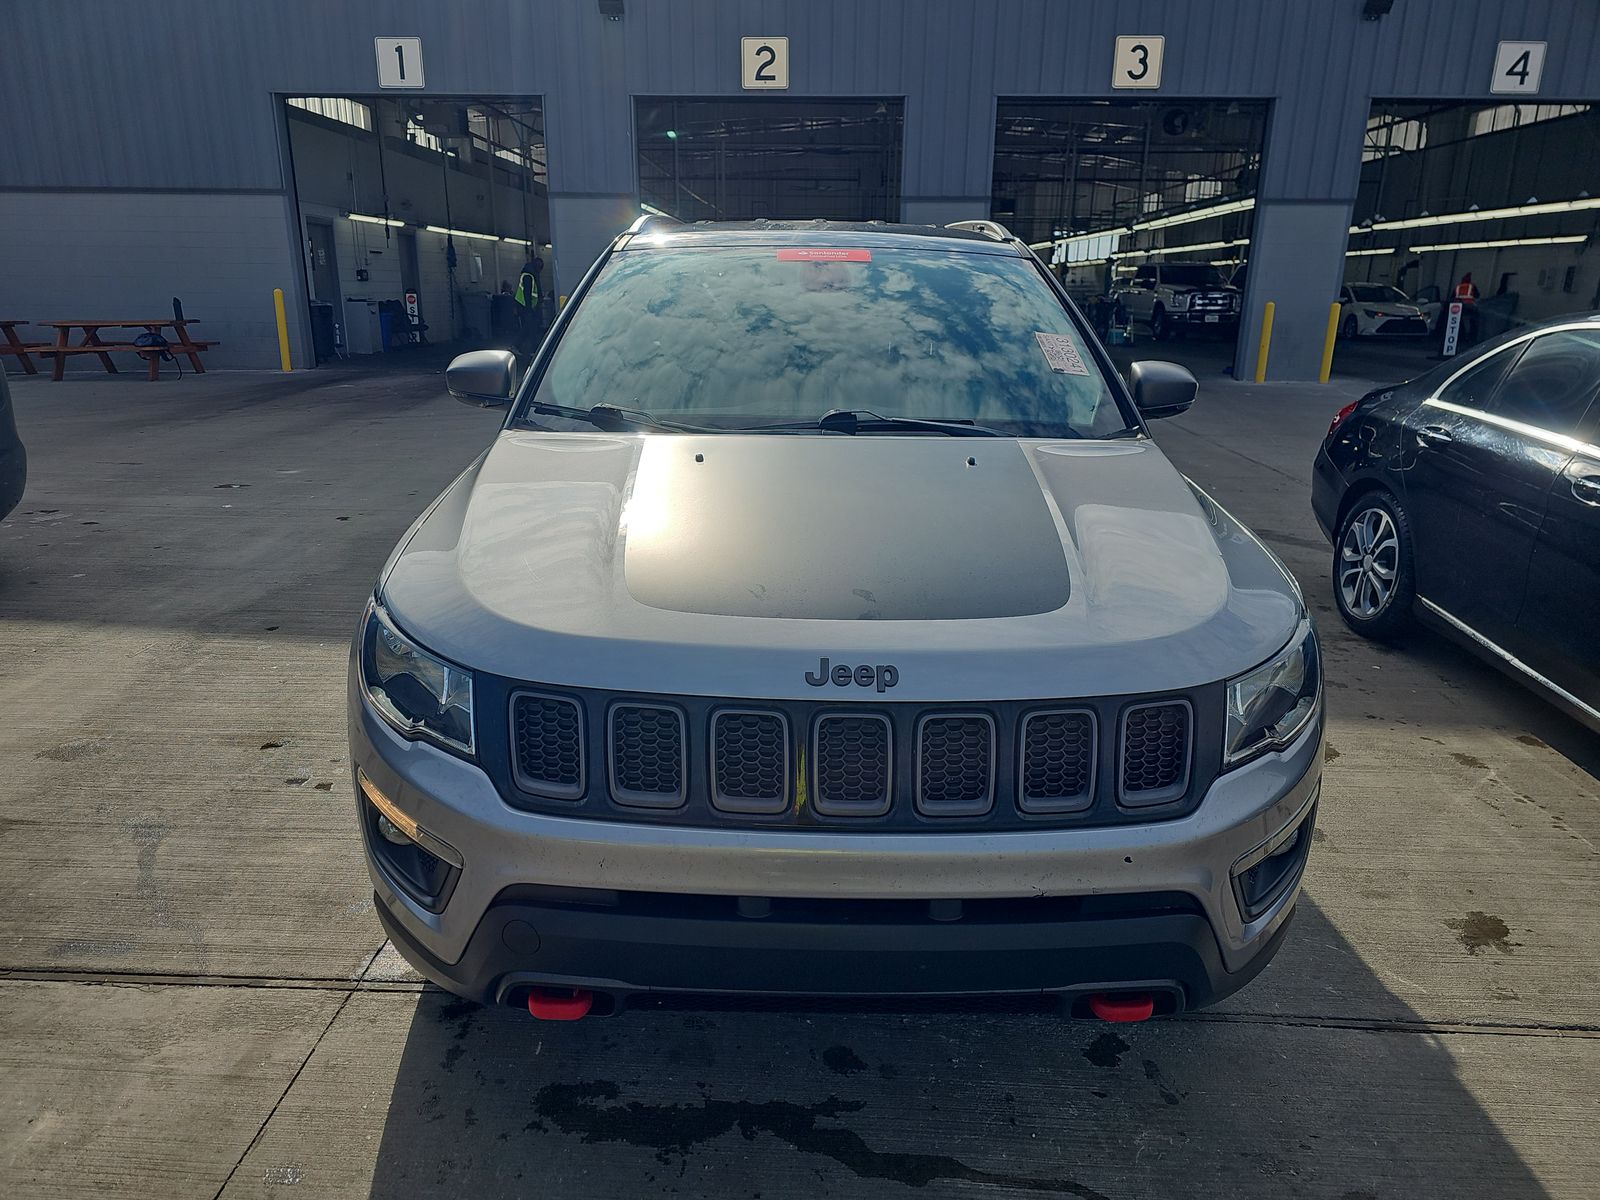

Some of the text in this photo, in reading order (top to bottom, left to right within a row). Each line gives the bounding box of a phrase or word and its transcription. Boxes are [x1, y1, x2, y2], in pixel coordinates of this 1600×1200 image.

[395, 45, 405, 80] 1
[755, 45, 776, 81] 2
[1127, 44, 1149, 80] 3
[1505, 50, 1531, 86] 4
[1447, 316, 1458, 353] STOP
[804, 657, 900, 693] Jeep
